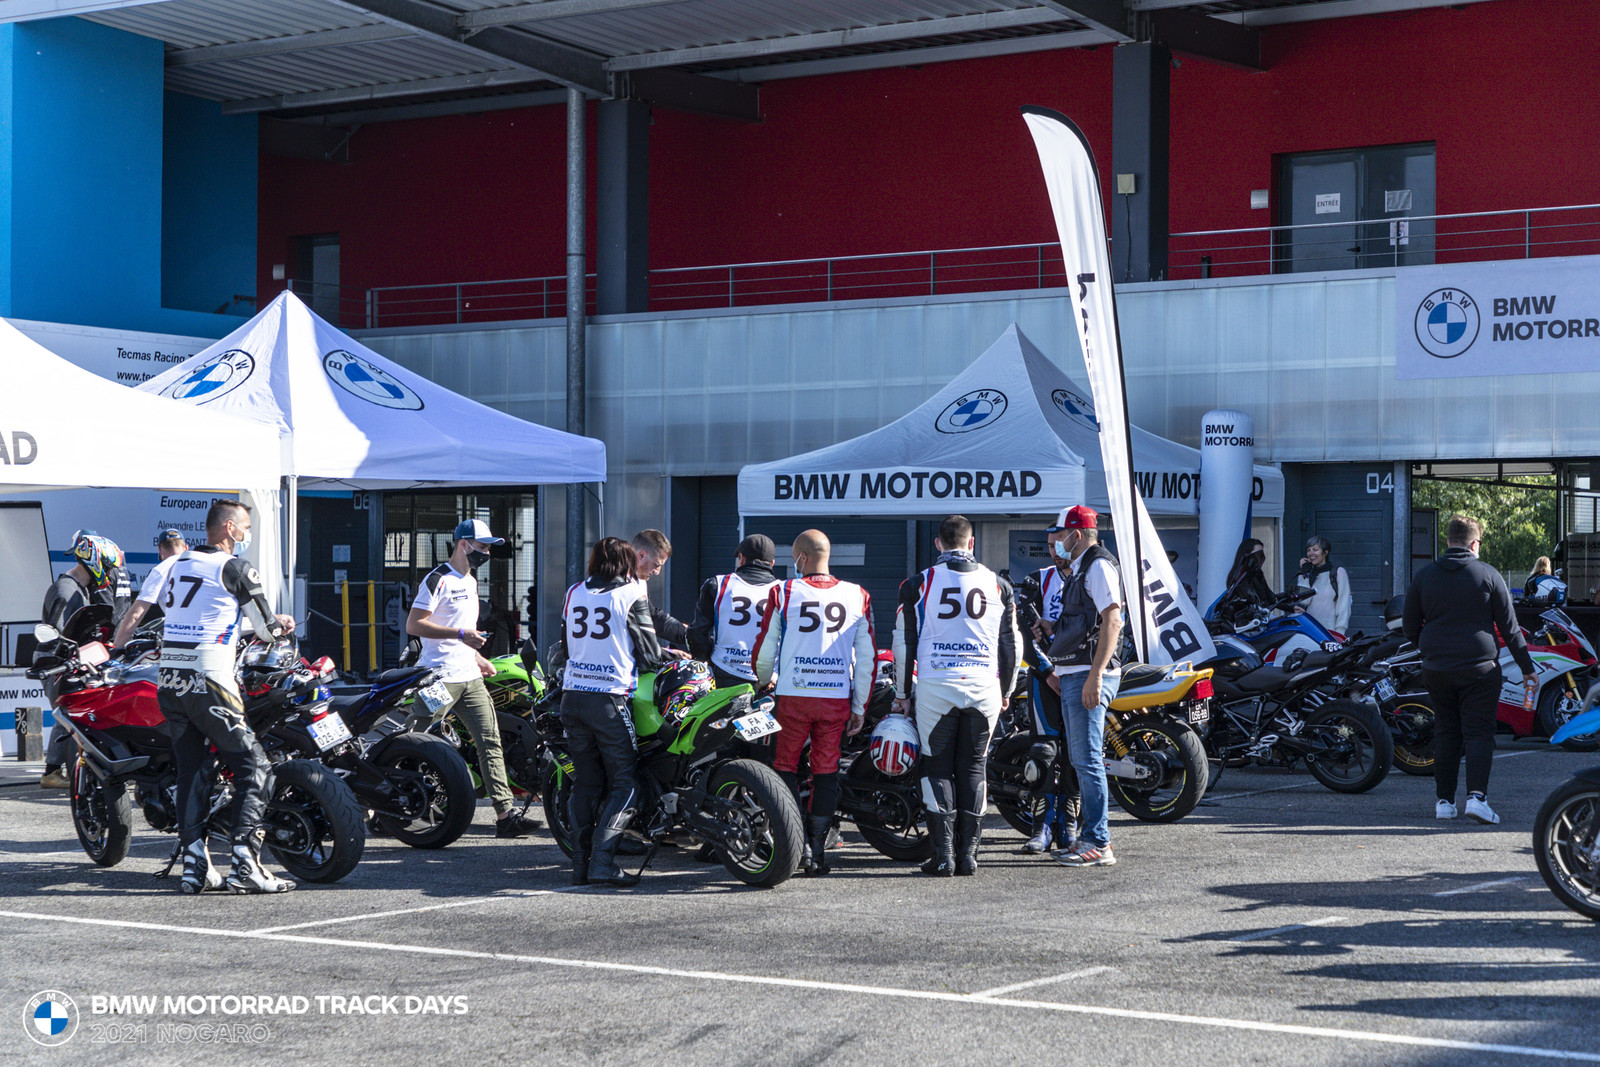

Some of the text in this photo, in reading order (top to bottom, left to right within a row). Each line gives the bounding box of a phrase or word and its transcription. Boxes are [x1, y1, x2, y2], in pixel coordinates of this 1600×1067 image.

[1316, 198, 1339, 208] ENTRÉE
[1493, 295, 1557, 317] BMW
[116, 347, 151, 361] Tecmas
[154, 352, 185, 364] Racing
[1205, 424, 1235, 435] BMW
[774, 470, 1042, 500] BMW MOTORRAD
[1366, 472, 1394, 494] 04
[160, 495, 208, 511] European
[157, 520, 197, 532] Alexandre
[937, 586, 988, 620] 50
[571, 605, 612, 641] 33
[798, 601, 847, 634] 59
[931, 642, 990, 651] TRACKDAYS
